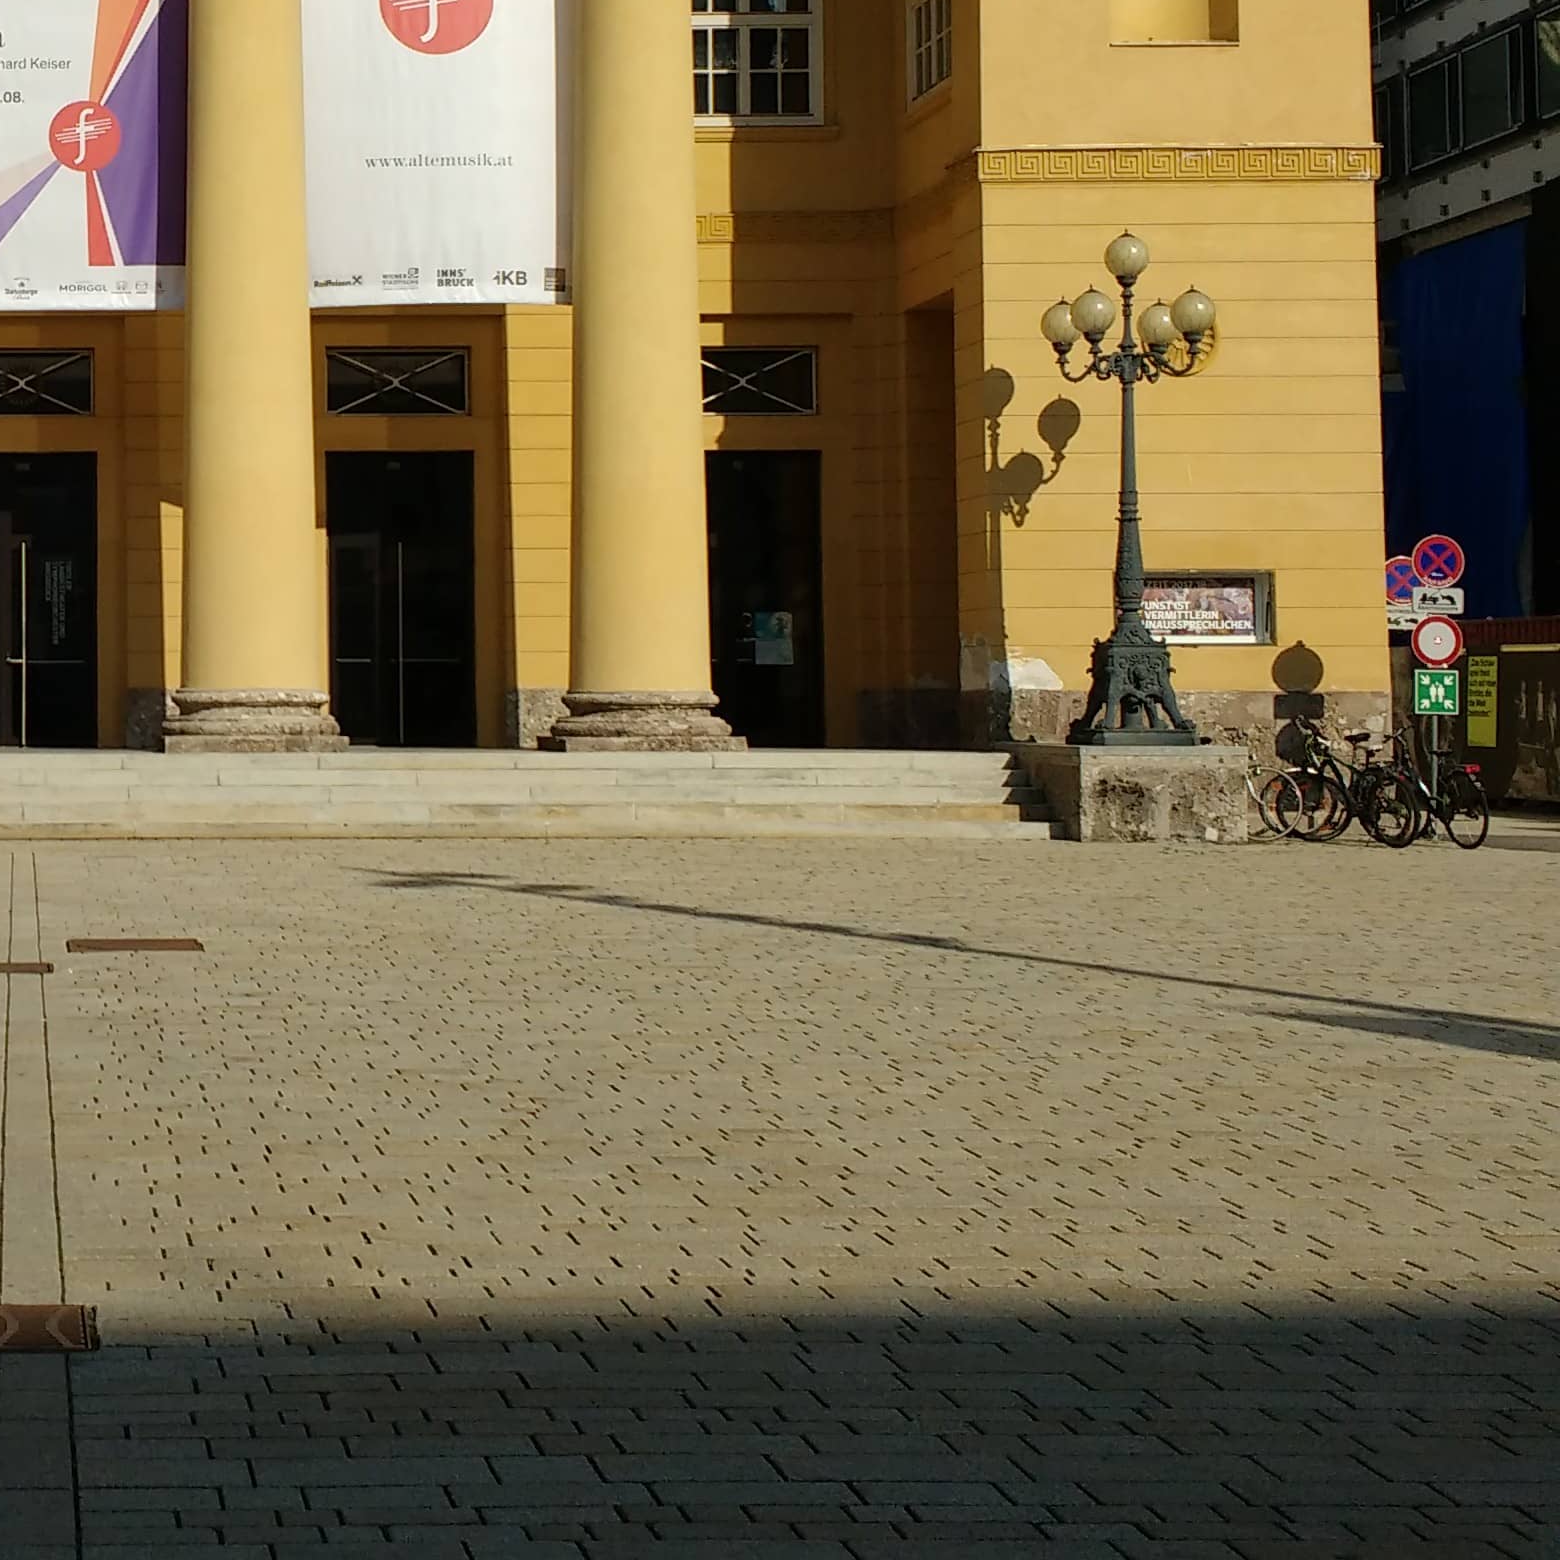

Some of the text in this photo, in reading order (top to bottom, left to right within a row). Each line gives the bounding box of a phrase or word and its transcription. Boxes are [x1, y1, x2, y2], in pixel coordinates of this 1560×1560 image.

[30, 58, 71, 70] Keiser
[364, 152, 513, 169] www.altemusik.at
[436, 278, 474, 287] BRUCK
[1144, 610, 1219, 620] VERMITTLERIN
